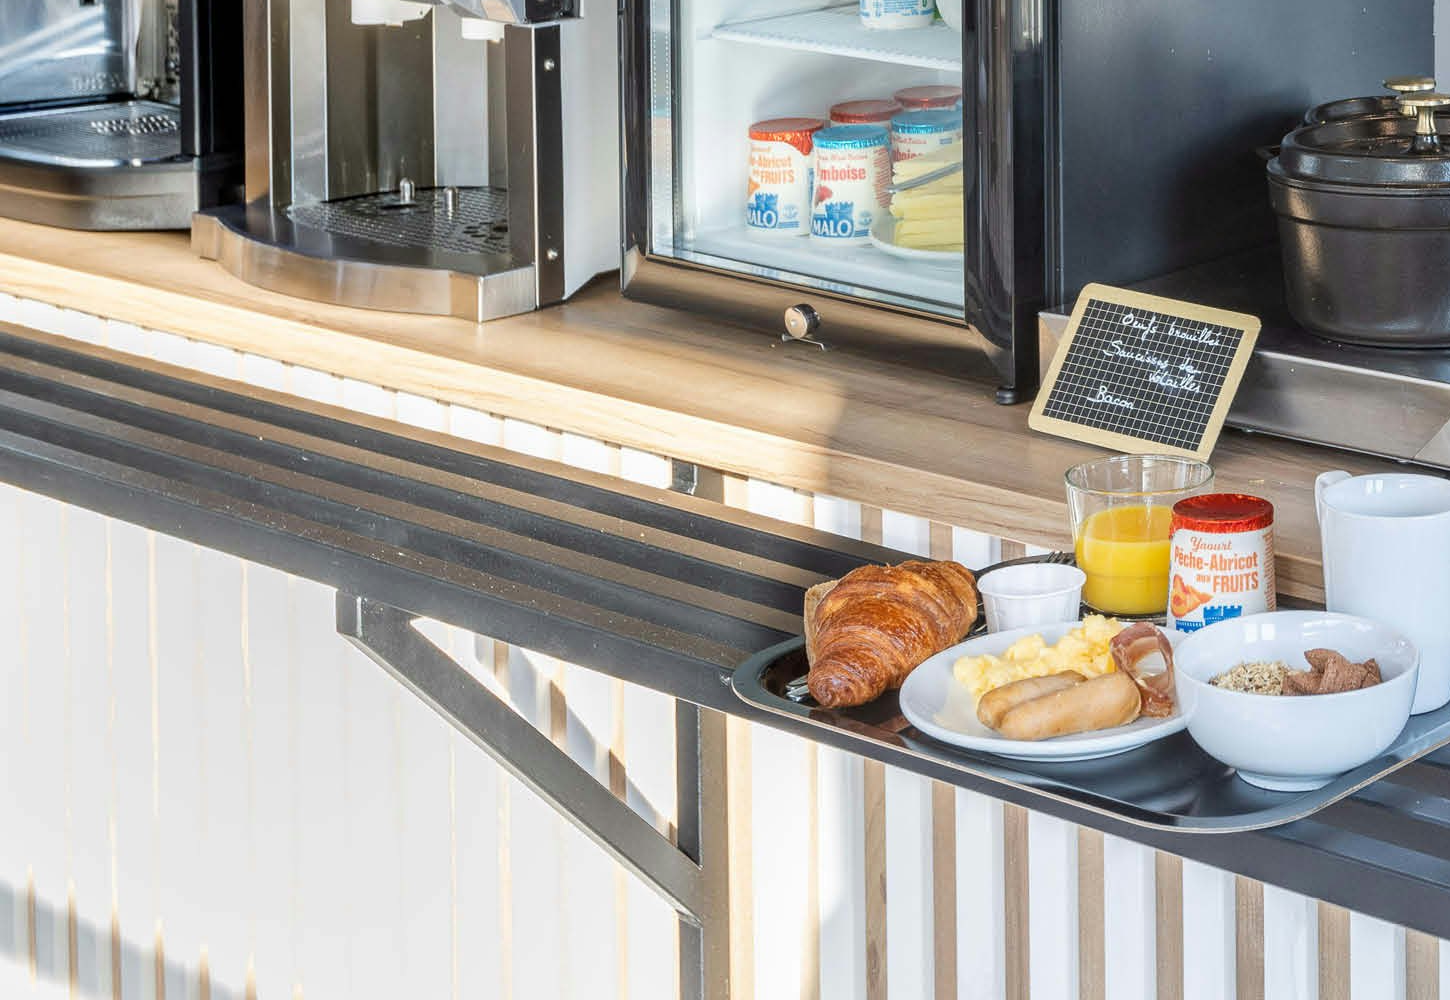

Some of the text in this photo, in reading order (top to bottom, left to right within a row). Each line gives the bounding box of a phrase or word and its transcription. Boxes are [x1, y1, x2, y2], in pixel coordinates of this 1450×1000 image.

[1086, 385, 1136, 411] Bacon
[1189, 536, 1233, 552] Yaourt
[1173, 545, 1259, 571] Pêche-Abricot
[1212, 571, 1260, 593] FRUITS
